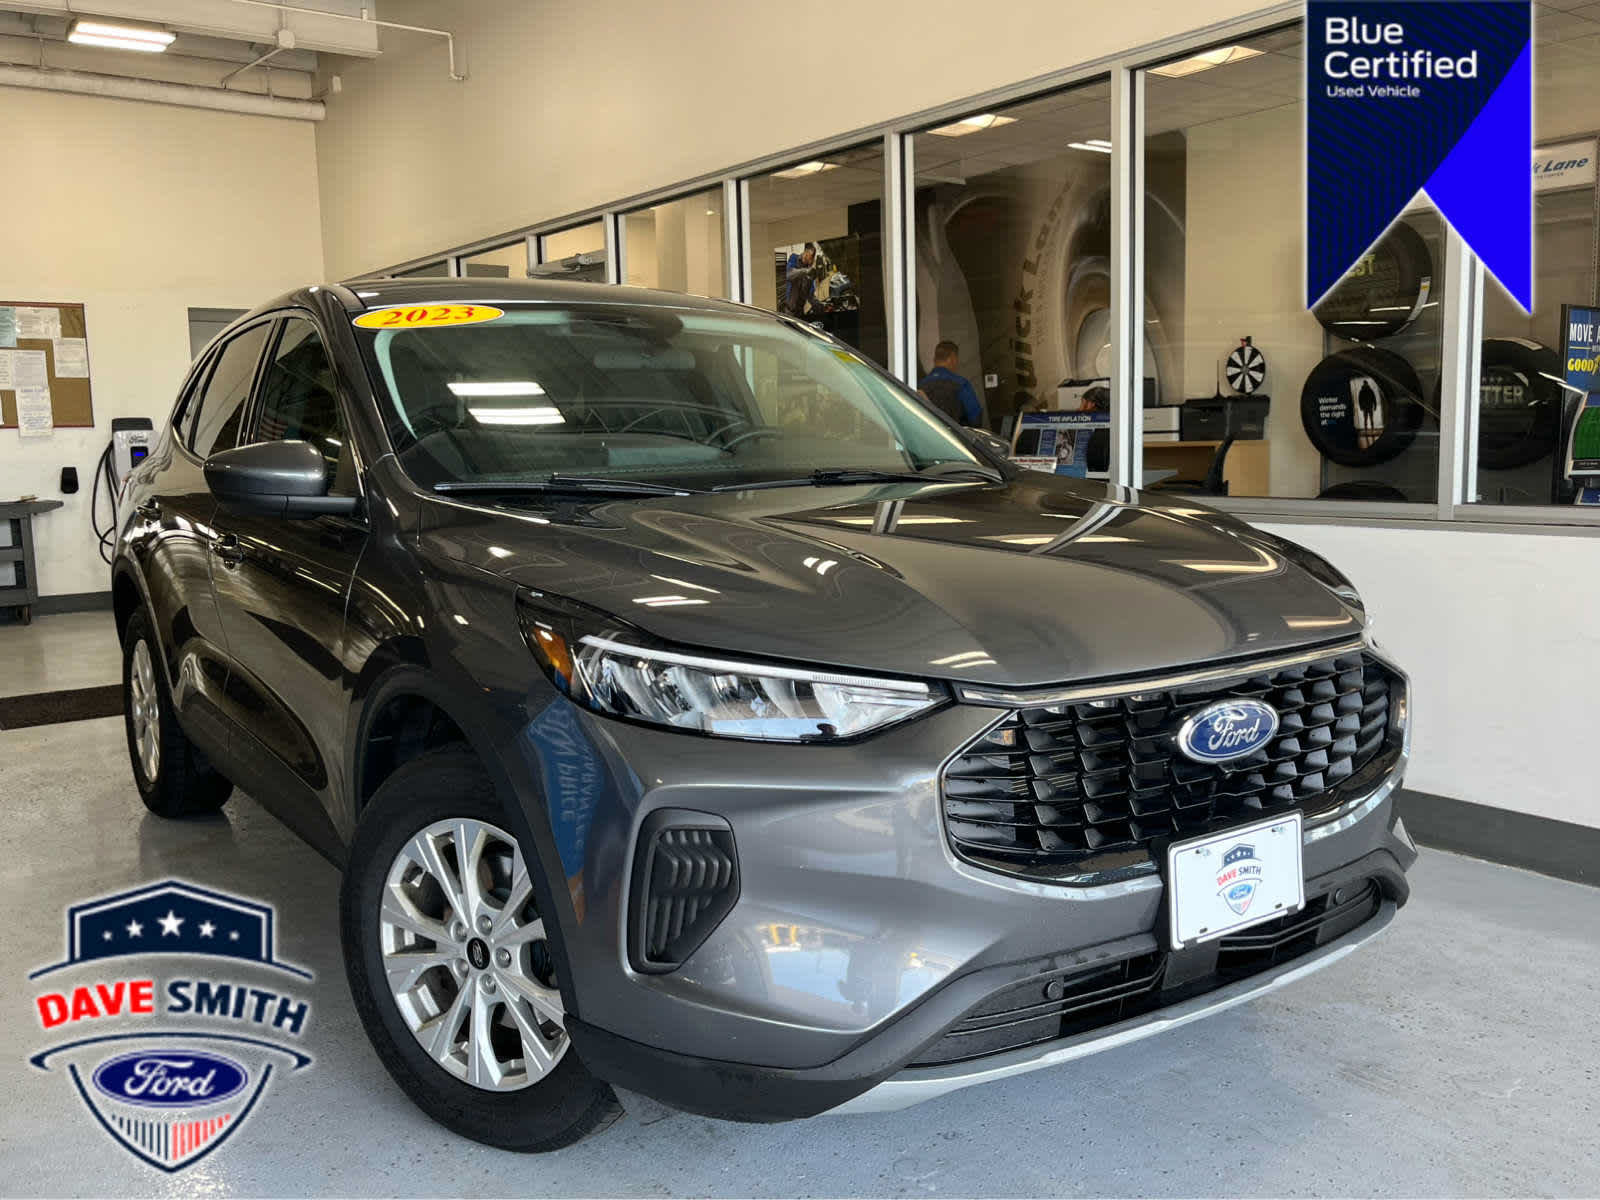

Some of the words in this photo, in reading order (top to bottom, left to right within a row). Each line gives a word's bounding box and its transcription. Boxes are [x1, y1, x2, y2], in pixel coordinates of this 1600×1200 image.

[1543, 158, 1589, 173] Lane
[383, 306, 475, 325] 2023
[1570, 323, 1594, 342] MOVE
[1208, 709, 1260, 750] Ford
[1216, 868, 1237, 886] DAVE
[1238, 866, 1262, 876] SMITH
